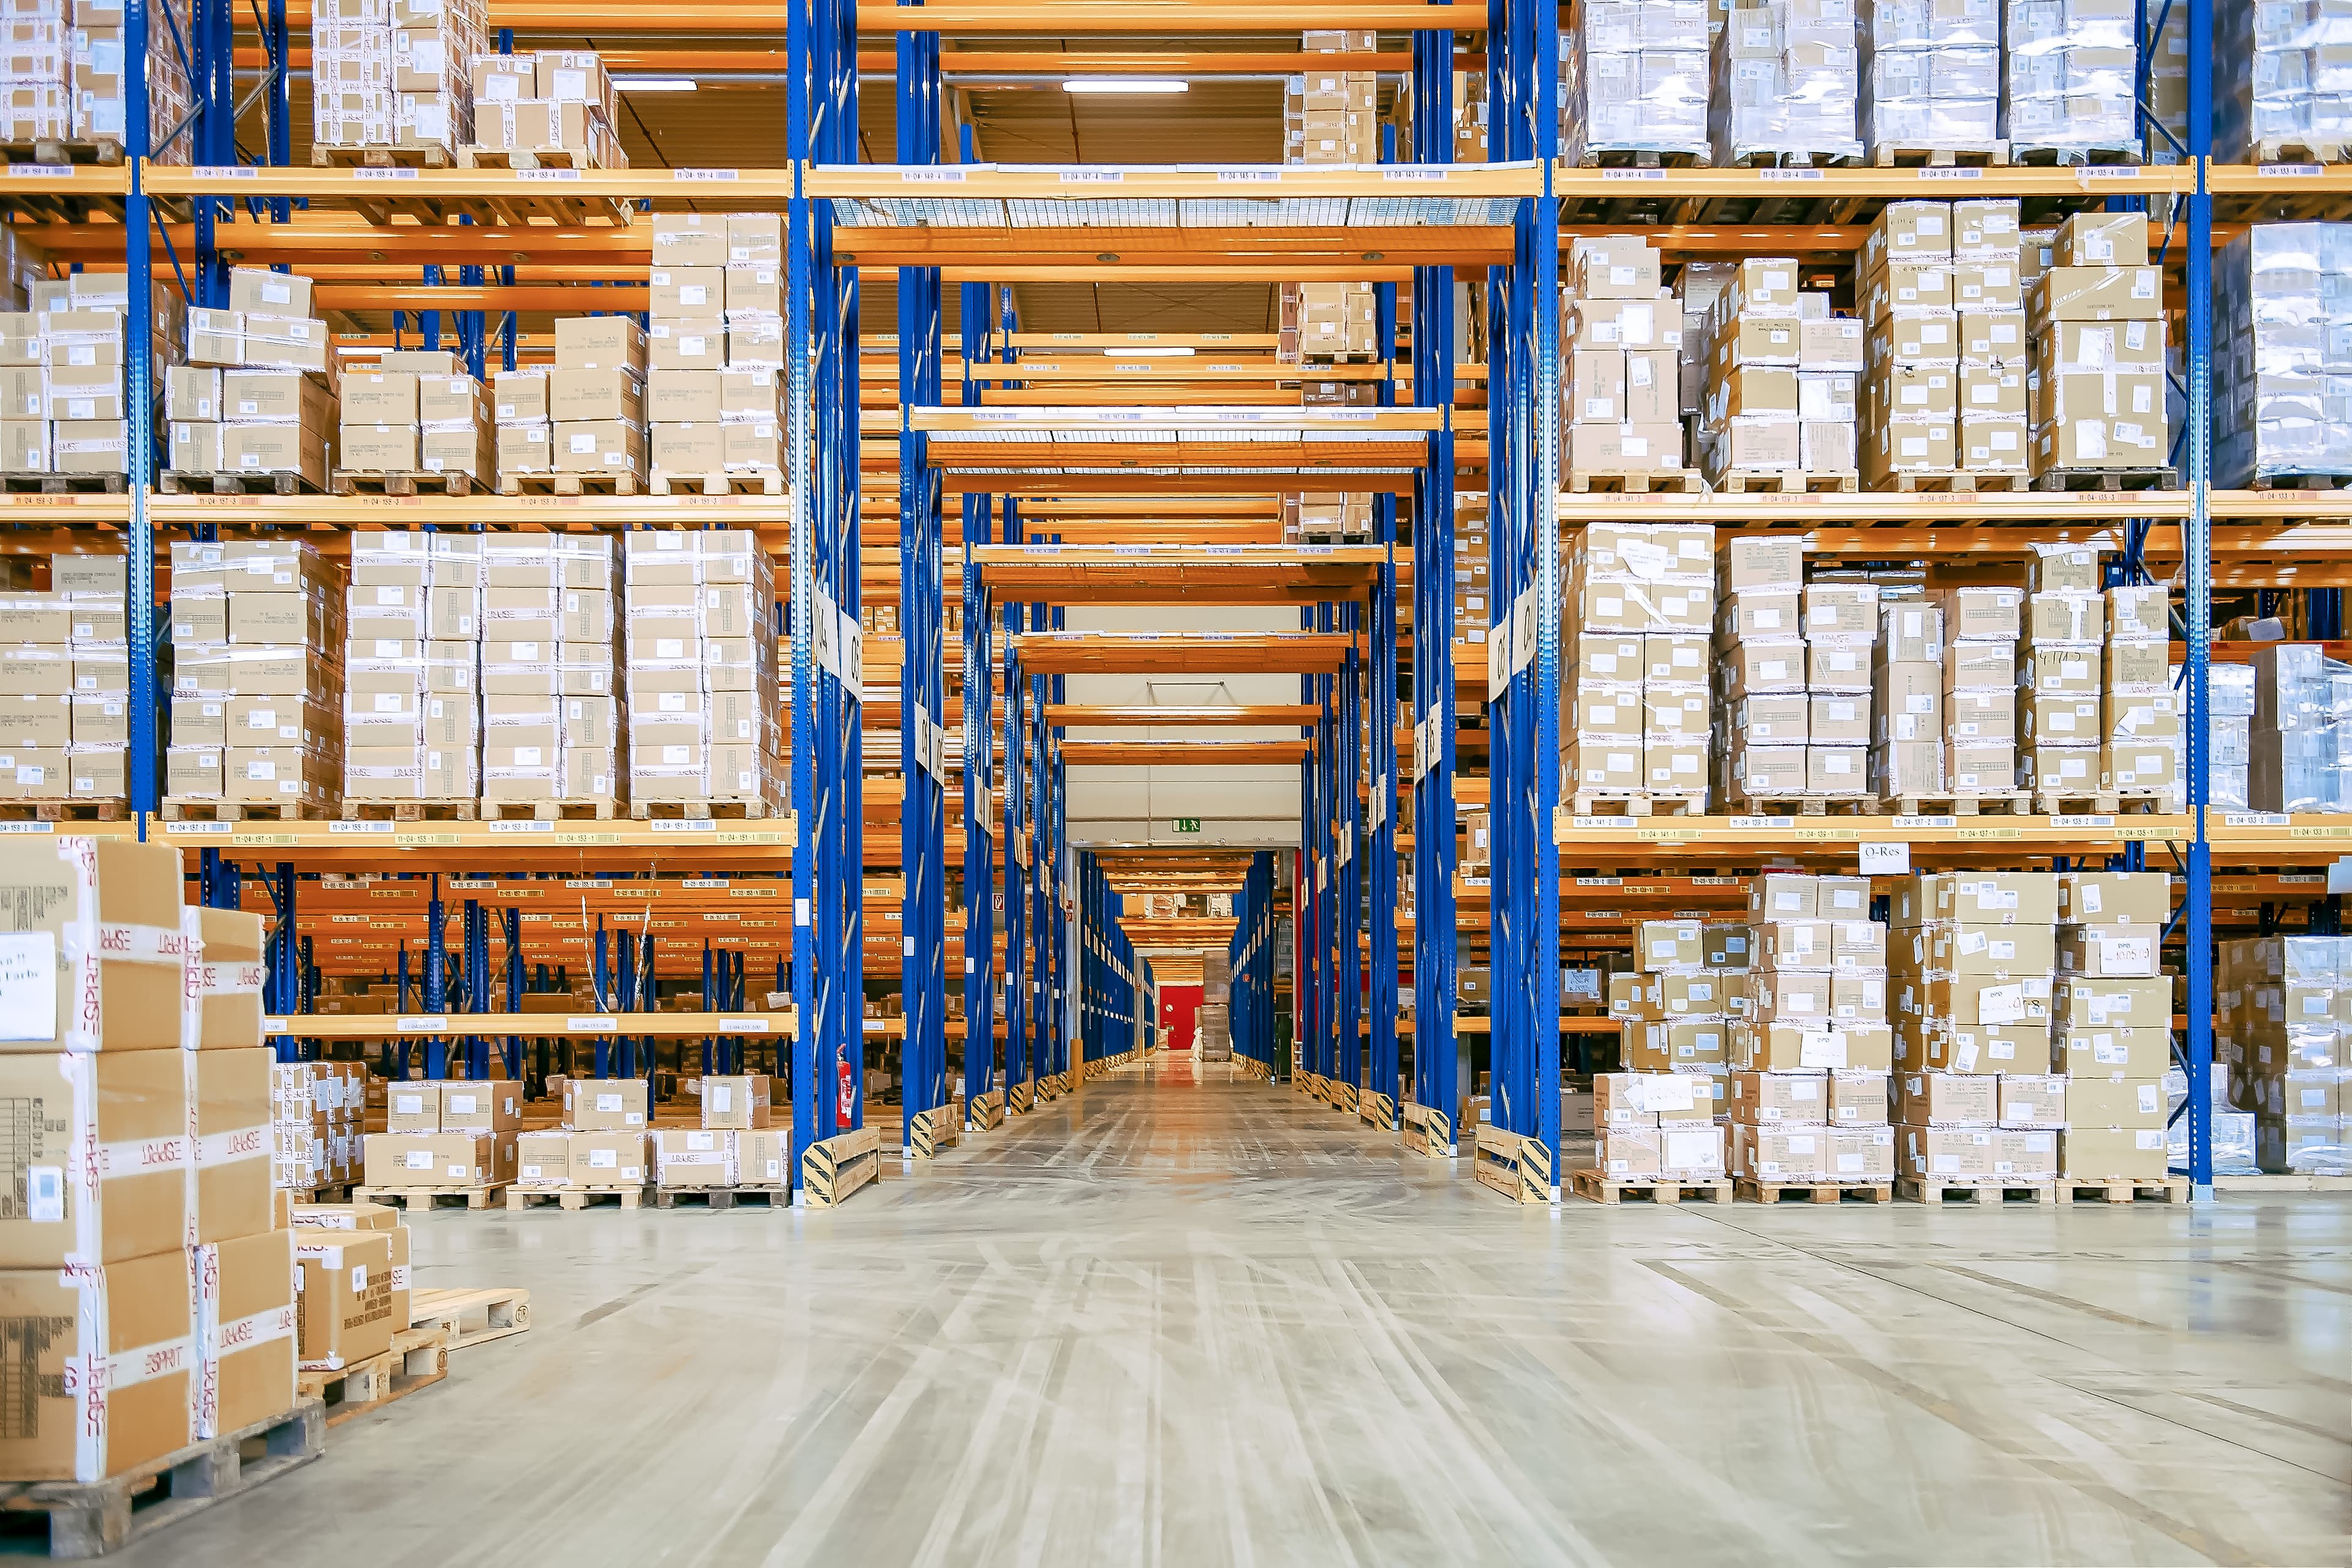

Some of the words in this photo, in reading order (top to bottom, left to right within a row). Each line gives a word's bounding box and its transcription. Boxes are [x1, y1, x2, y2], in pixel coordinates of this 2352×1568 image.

[141, 1140, 182, 1165] ESPRIT
[227, 1130, 260, 1154] ESPRIT
[145, 1346, 184, 1375] ESPRIT
